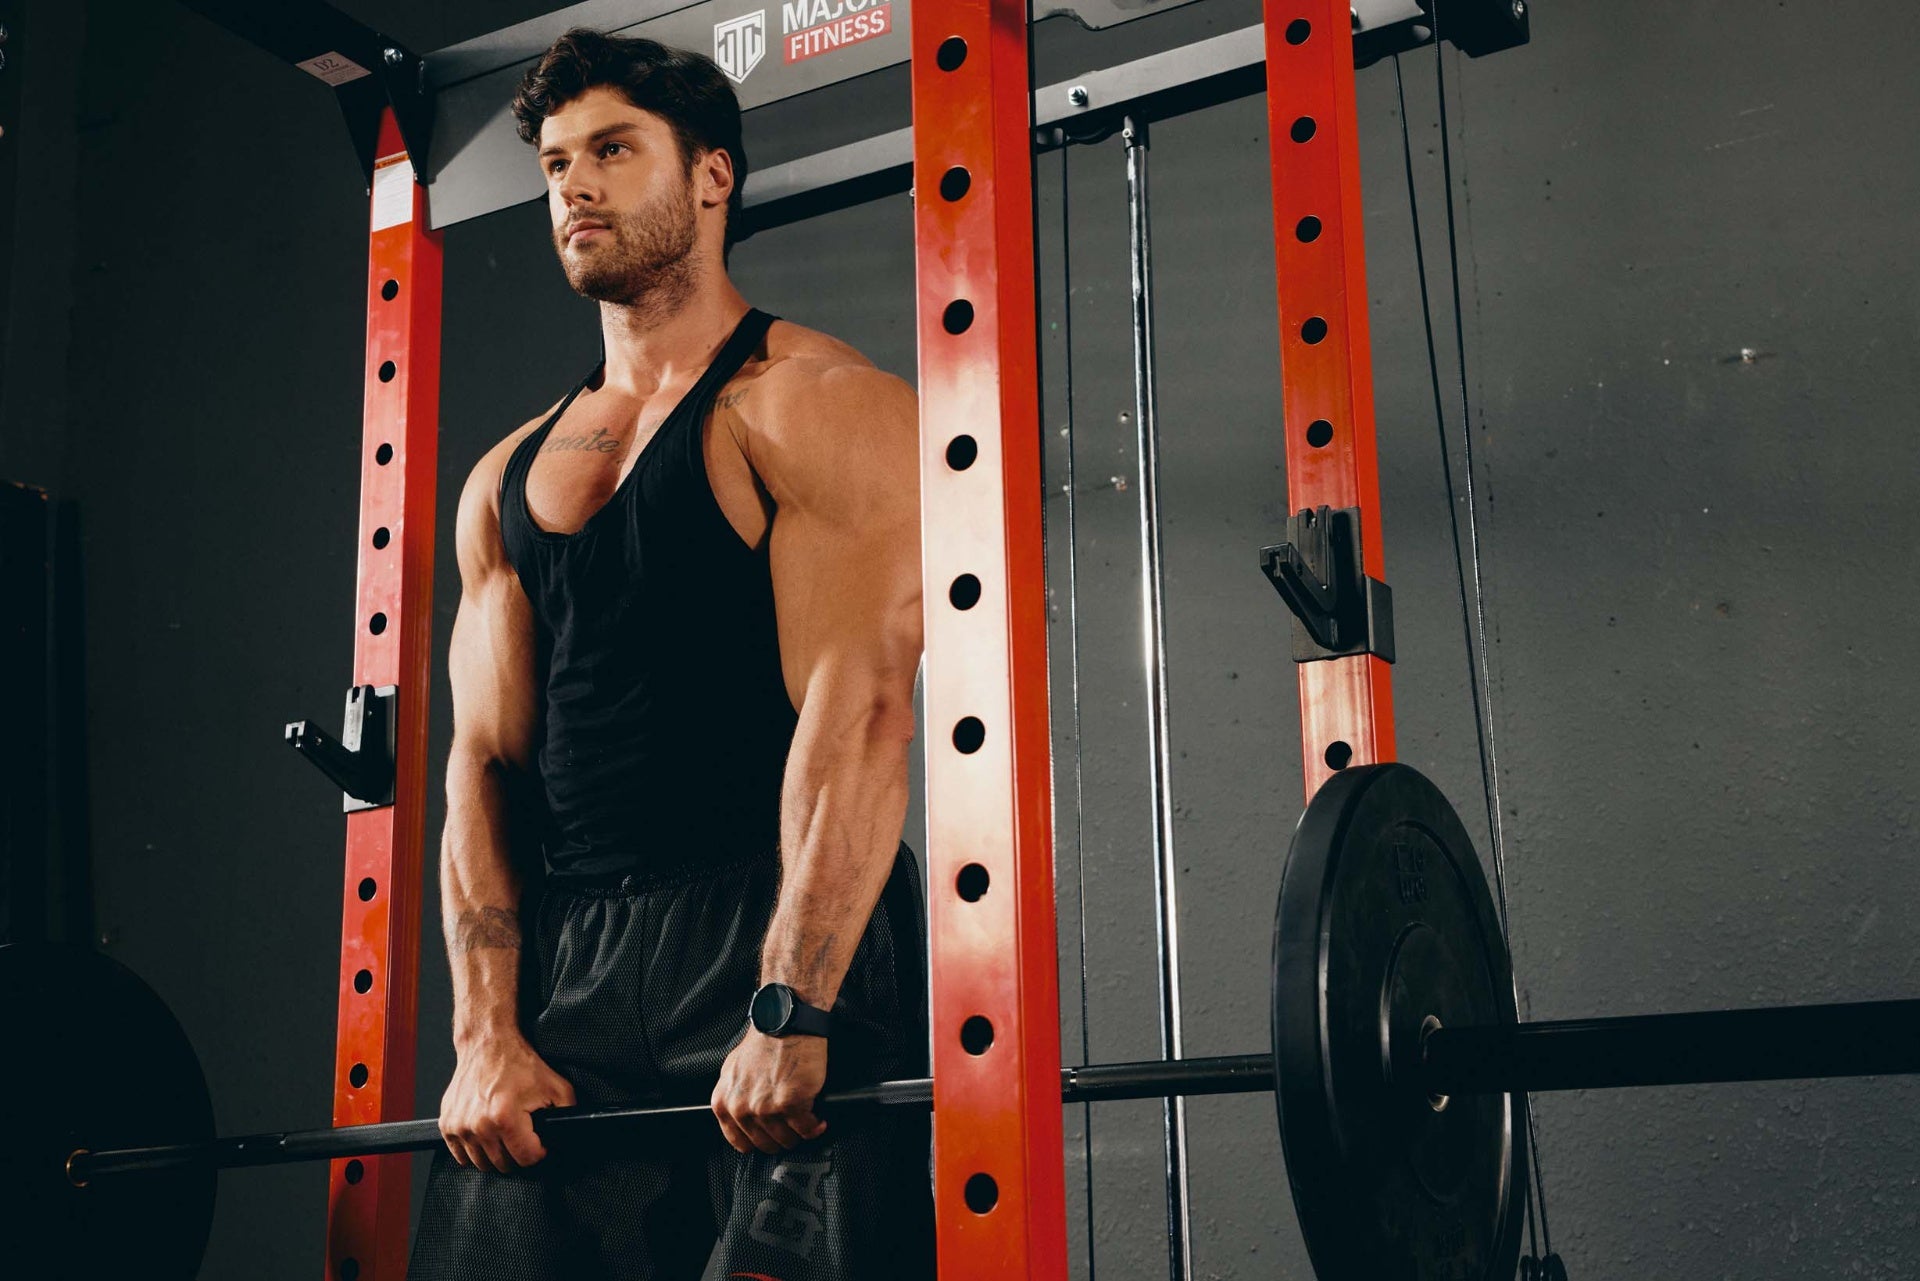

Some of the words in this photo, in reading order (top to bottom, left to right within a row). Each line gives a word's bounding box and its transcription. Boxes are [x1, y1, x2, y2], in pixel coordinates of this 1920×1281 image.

[782, 0, 889, 34] MAJ
[791, 10, 885, 59] FITNESS
[748, 1147, 833, 1260] GA
